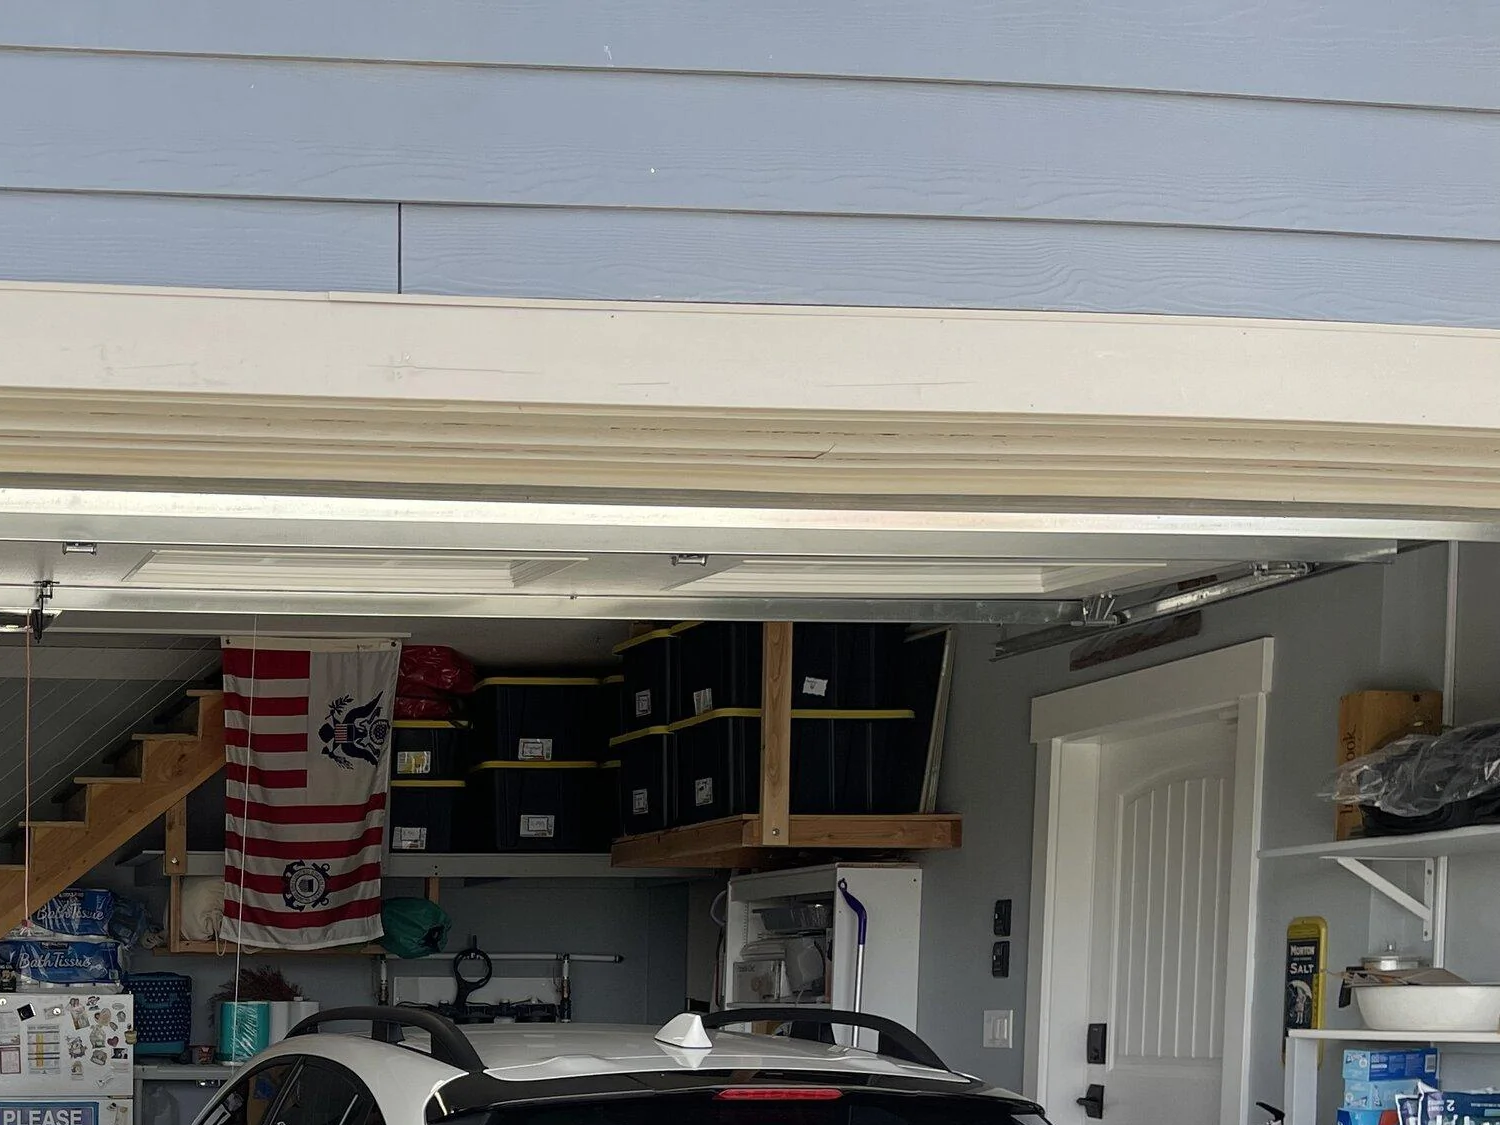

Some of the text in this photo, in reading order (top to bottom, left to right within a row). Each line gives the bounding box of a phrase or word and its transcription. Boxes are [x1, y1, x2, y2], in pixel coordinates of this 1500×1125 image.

[1290, 945, 1315, 956] MORTON
[18, 951, 93, 969] Bath Tissue
[1290, 962, 1314, 974] SALT
